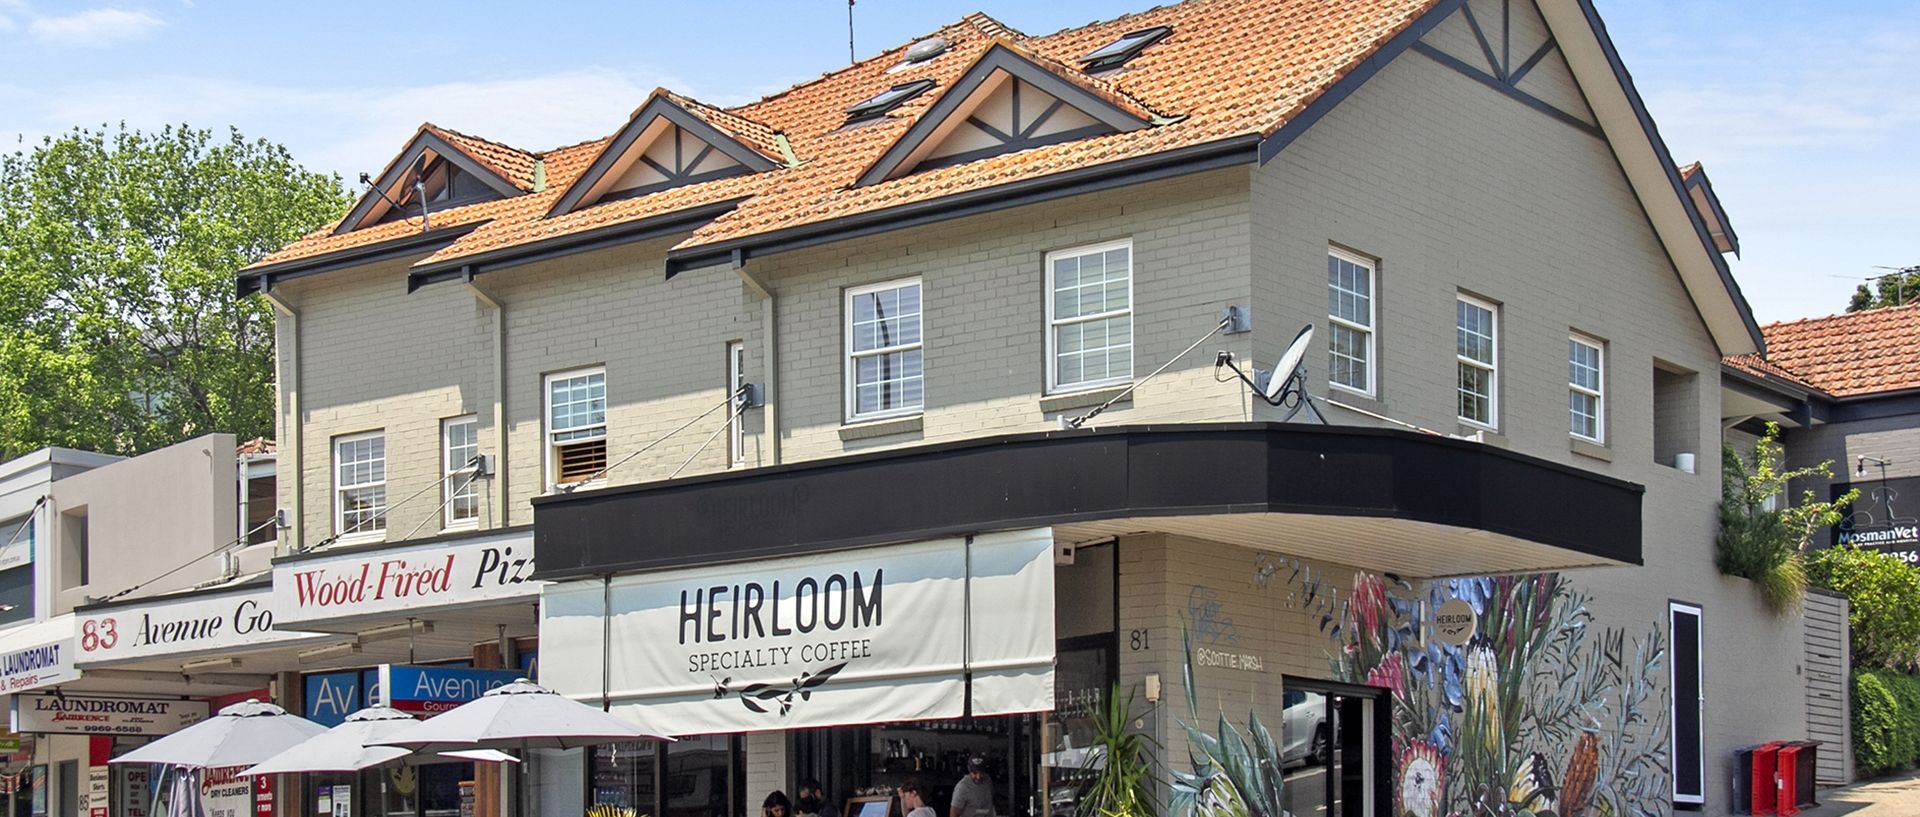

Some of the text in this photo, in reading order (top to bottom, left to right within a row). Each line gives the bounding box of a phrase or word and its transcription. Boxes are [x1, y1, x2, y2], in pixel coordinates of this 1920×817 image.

[1838, 526, 1919, 543] MosmanVet
[294, 554, 456, 609] Wood-Fired
[679, 568, 883, 645] HEIRLOOM
[81, 600, 273, 652] 83 Avenue Go
[1436, 614, 1472, 624] HEIRLOOM
[1130, 628, 1150, 651] 81
[3, 644, 60, 676] LAUNDROMAT
[689, 639, 872, 673] SPECIALTY COFFEE
[10, 674, 39, 690] Repairs
[35, 698, 170, 715] LAUNDROMAT
[210, 786, 249, 799] DRY CLEANERS
[260, 776, 267, 789] 3
